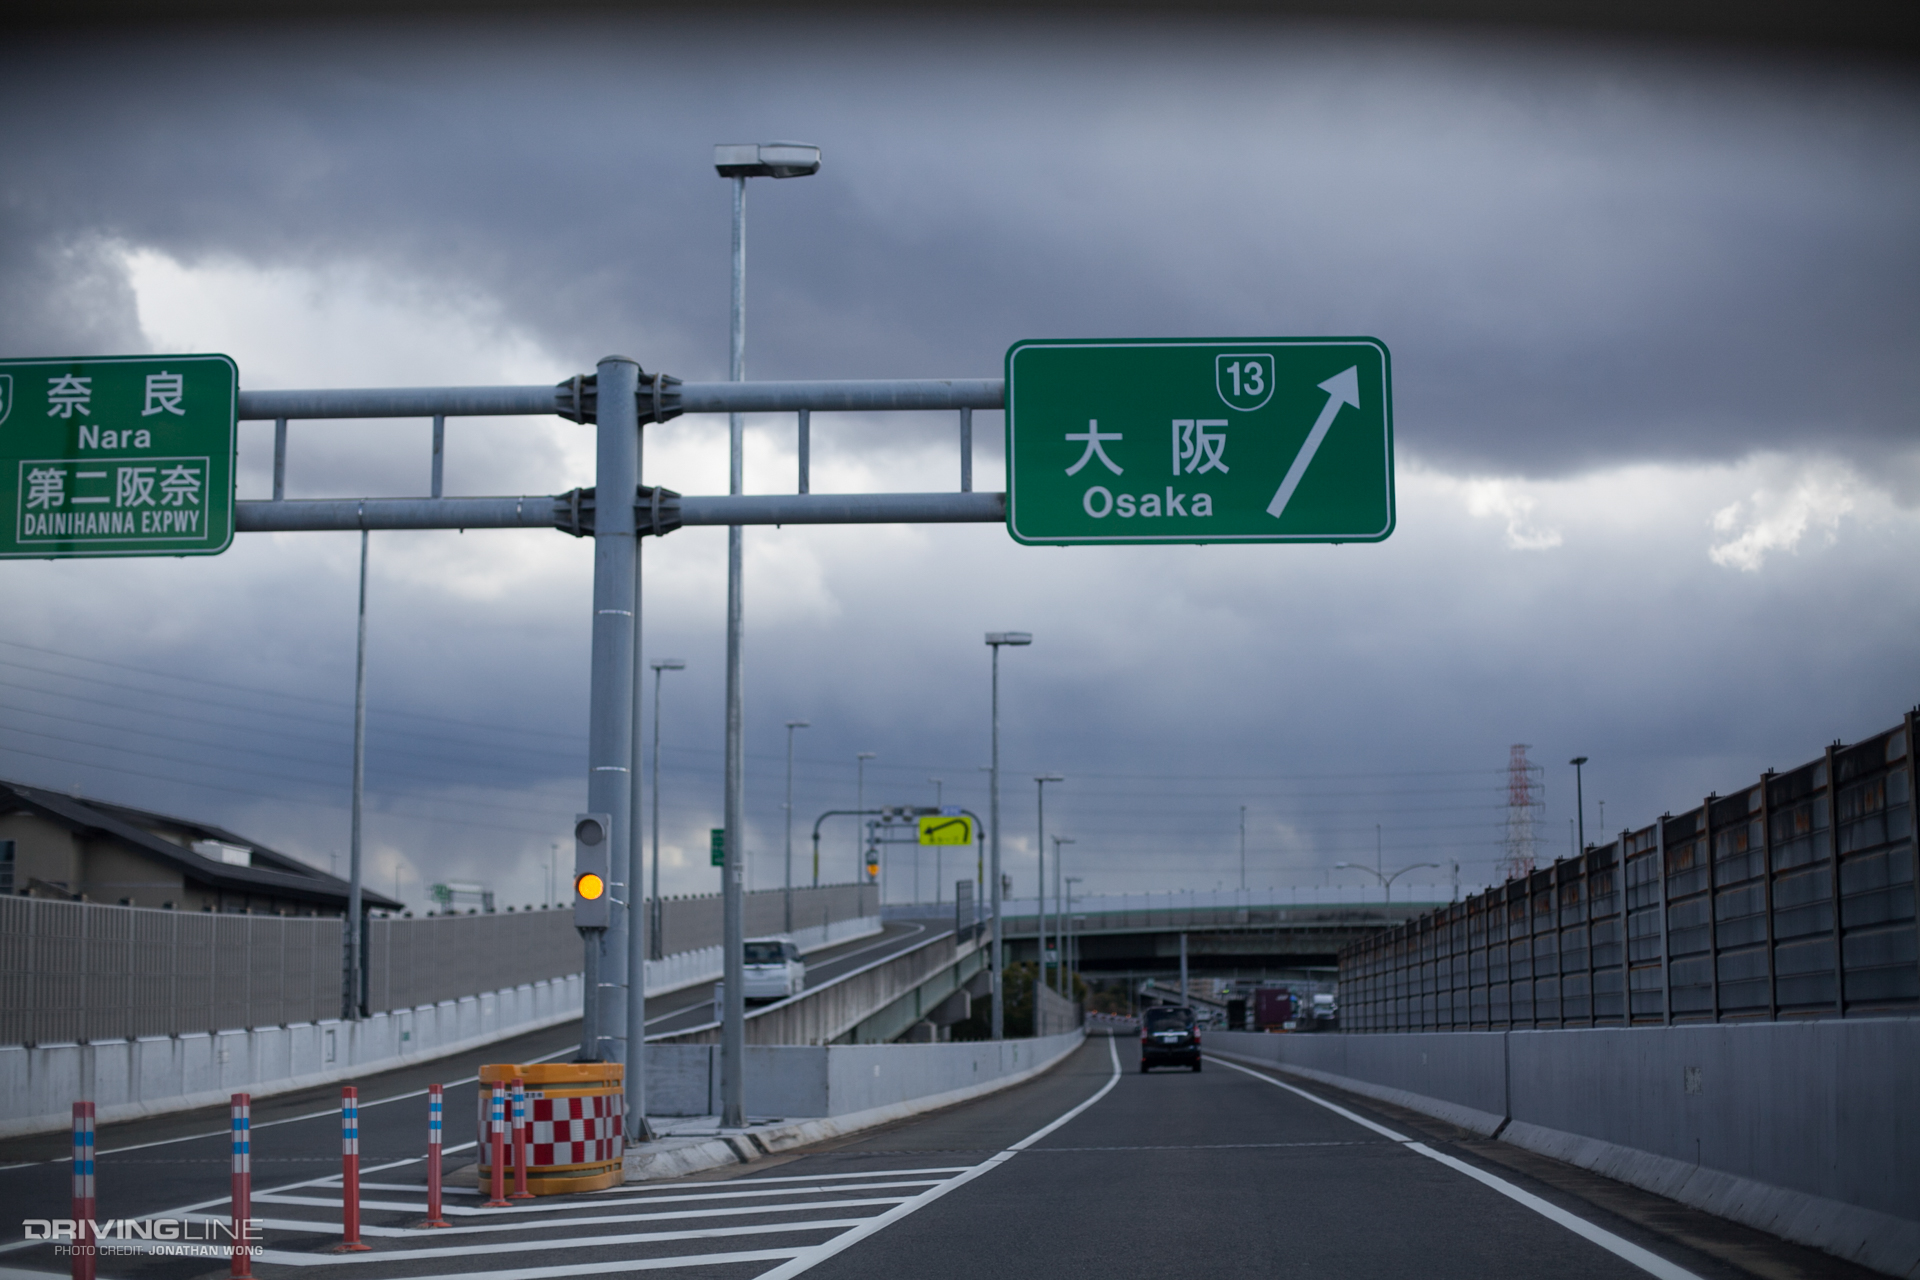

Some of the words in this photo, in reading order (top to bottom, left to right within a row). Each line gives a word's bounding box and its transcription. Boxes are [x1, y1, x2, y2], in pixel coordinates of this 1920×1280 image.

[46, 370, 186, 419] 奈良
[1226, 361, 1265, 396] 13
[78, 425, 151, 449] Nara
[1064, 419, 1230, 477] 大阪
[26, 465, 201, 509] 第二阪奈
[1082, 486, 1213, 518] Osaka
[24, 512, 135, 535] DAINIHANNA
[141, 510, 200, 532] EXPWY
